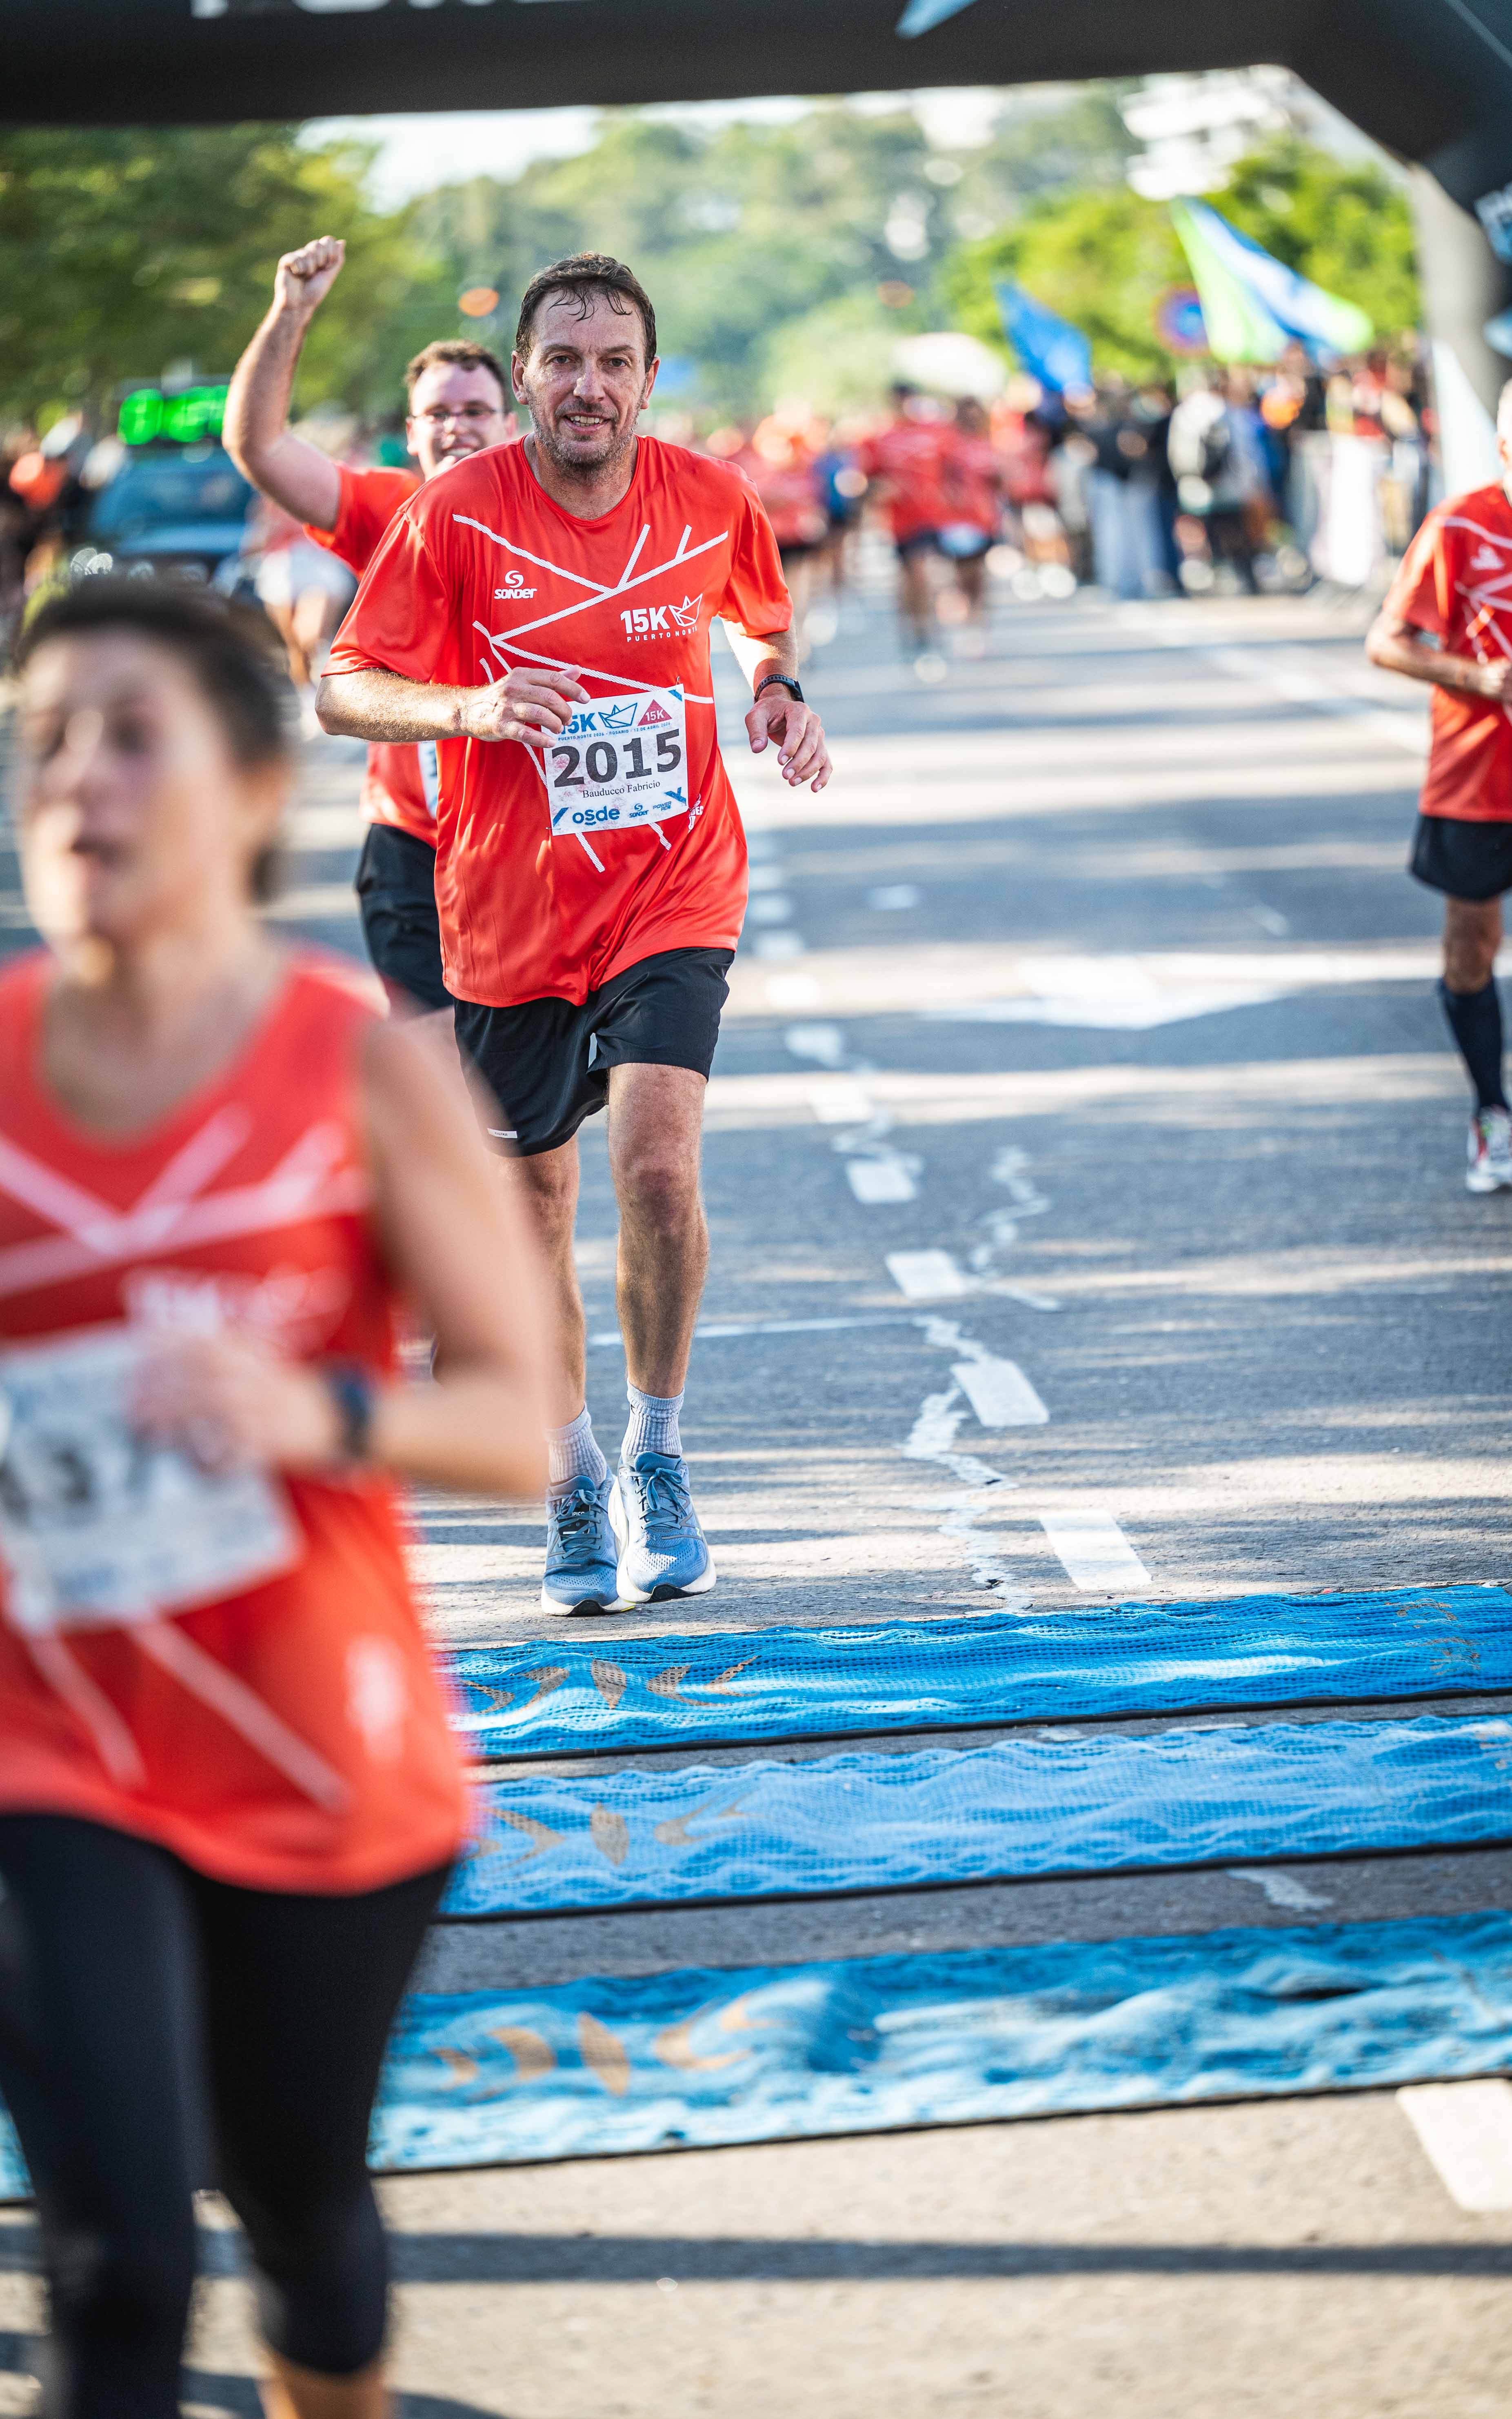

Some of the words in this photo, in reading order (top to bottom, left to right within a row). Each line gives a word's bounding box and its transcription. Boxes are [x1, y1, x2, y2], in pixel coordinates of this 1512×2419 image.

[620, 606, 670, 634] 15K
[627, 632, 671, 643] PUERTO
[645, 709, 664, 722] 15K
[551, 728, 682, 788] 2015
[583, 788, 625, 798] Bauducco
[627, 780, 660, 793] Fabricio
[572, 806, 620, 824] osde
